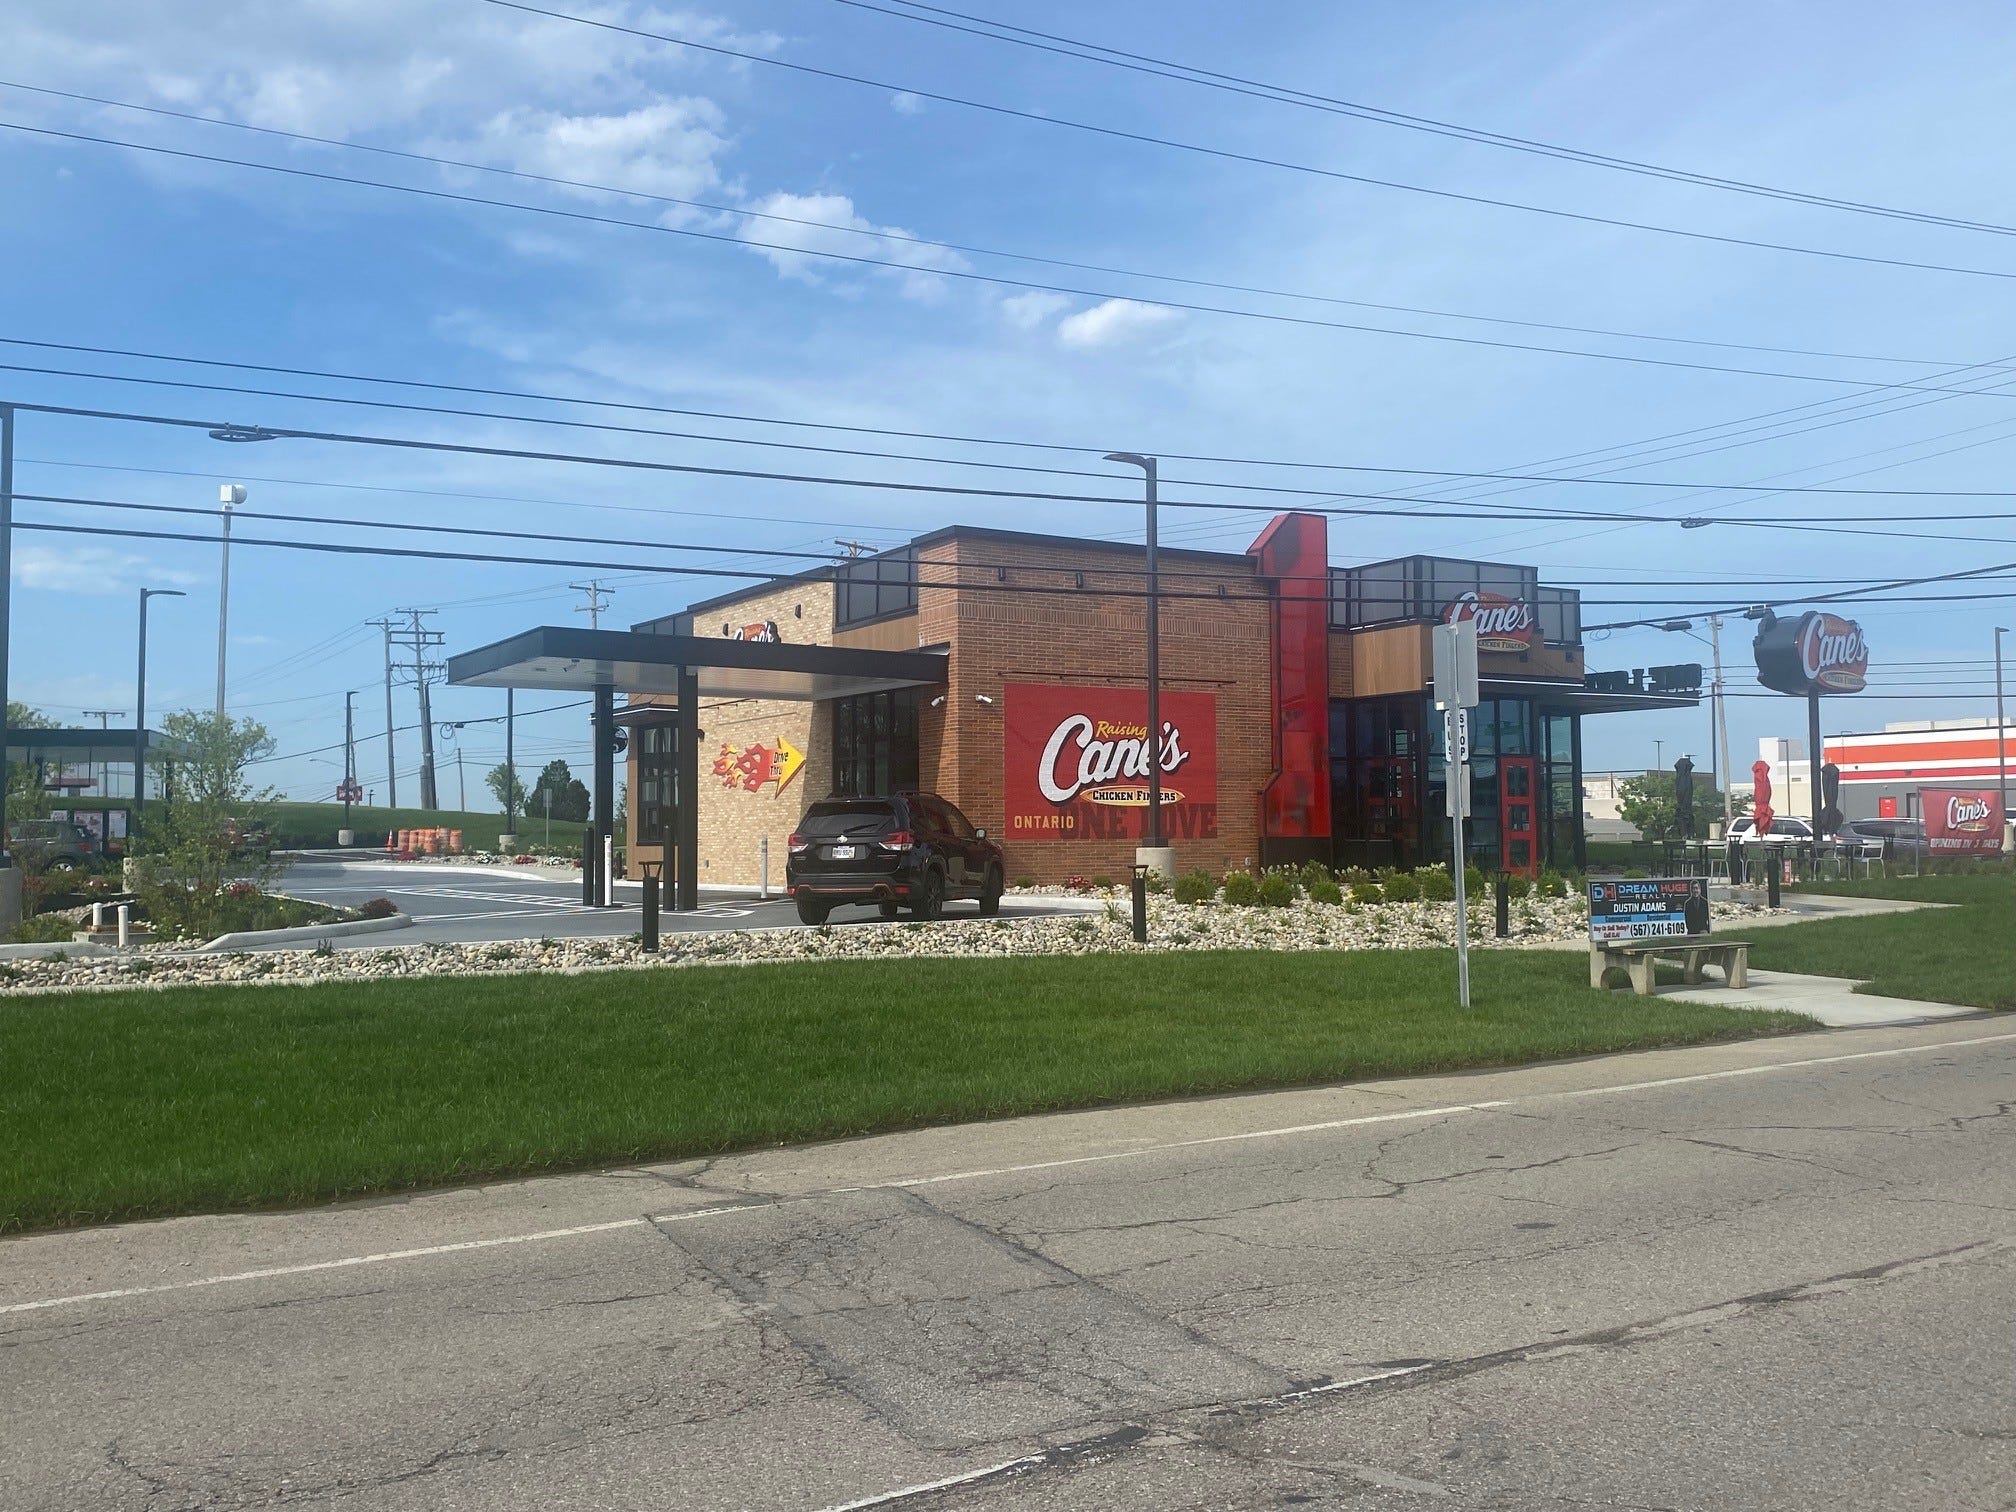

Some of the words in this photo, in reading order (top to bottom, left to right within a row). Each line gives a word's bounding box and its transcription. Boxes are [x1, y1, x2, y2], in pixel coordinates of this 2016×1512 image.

[1096, 721, 1147, 741] Raising
[1136, 790, 1176, 801] FINERS
[1947, 796, 1991, 829] Cane's
[1014, 815, 1074, 830] ONTARIO
[1058, 803, 1128, 839] ONE
[1618, 884, 1658, 893] DREAM
[1661, 883, 1688, 892] HUGE
[1613, 903, 1639, 913] DUSTIN
[1641, 902, 1667, 912] ADAMS
[1630, 923, 1650, 938] (567)
[1651, 922, 1685, 936] 241-6109
